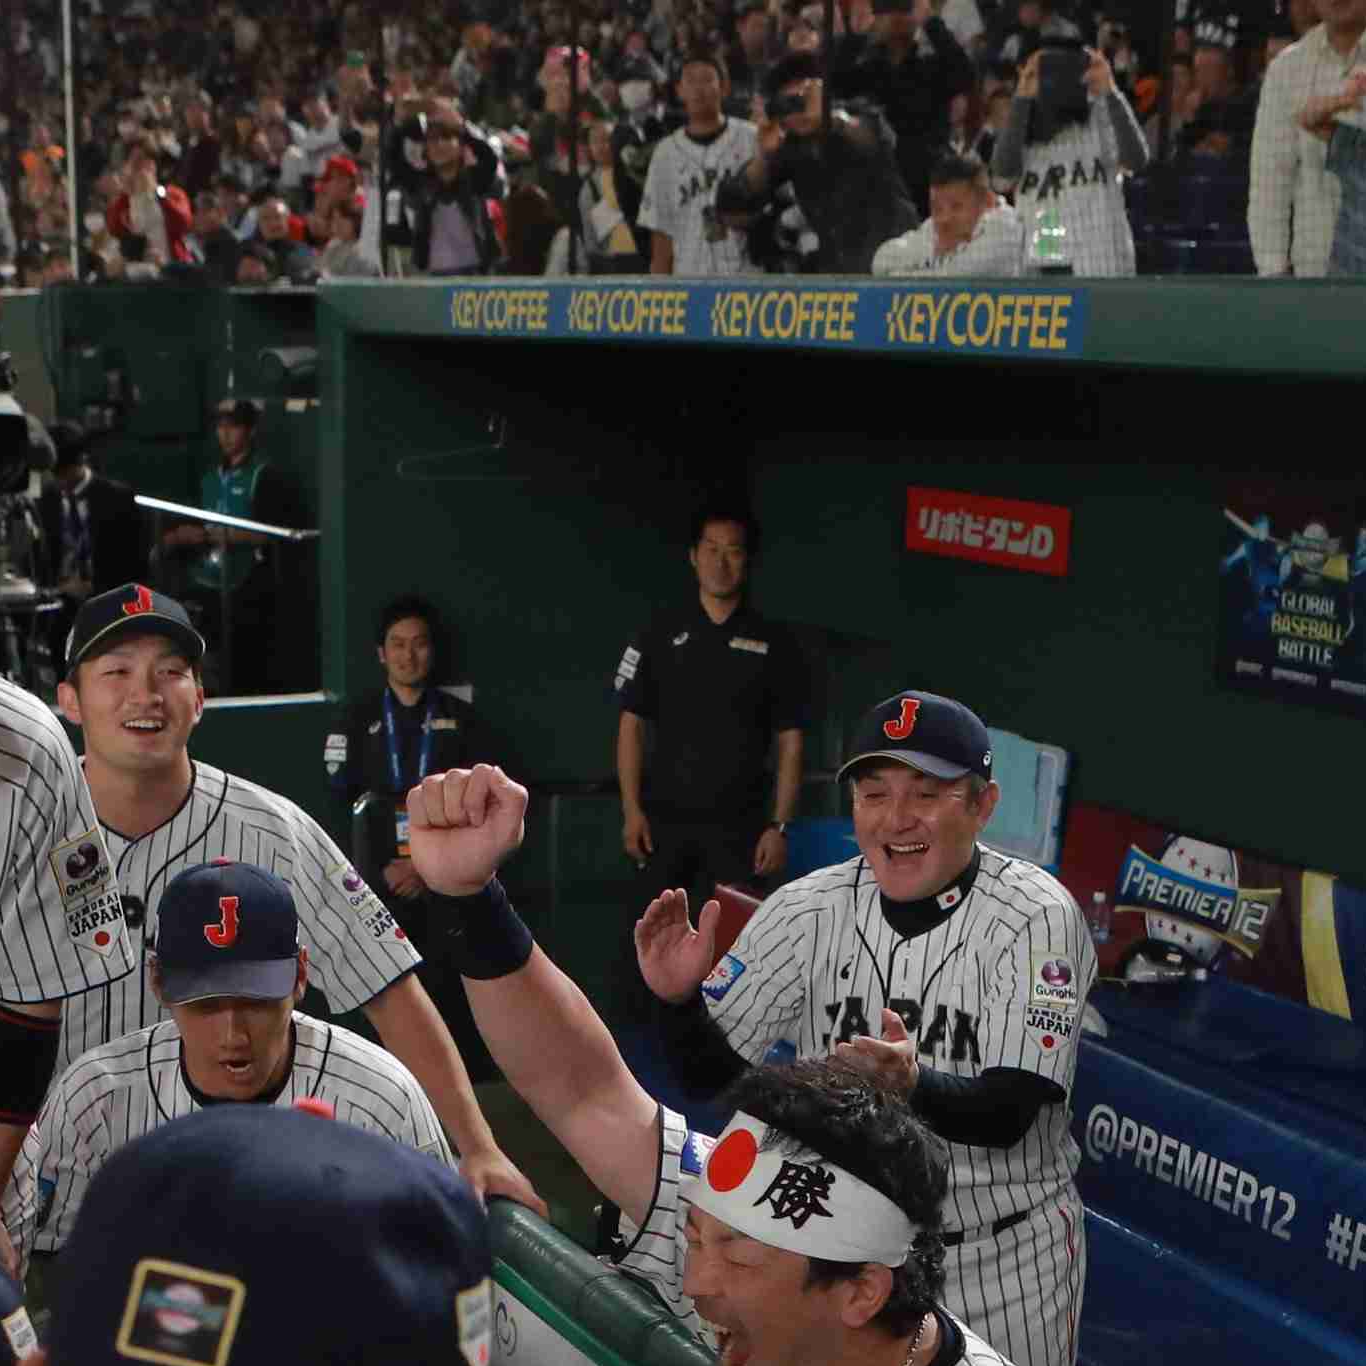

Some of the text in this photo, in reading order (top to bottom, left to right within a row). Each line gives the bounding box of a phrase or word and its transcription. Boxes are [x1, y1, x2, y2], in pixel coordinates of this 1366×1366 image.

[918, 506, 1055, 560] リポビタンD
[123, 584, 153, 616] J
[883, 697, 921, 740] J
[70, 902, 123, 938] JAPAN
[203, 895, 239, 948] J
[1026, 1014, 1073, 1039] JAPAN
[752, 1160, 836, 1230] 勝
[1084, 1103, 1297, 1241] @PREMIER12
